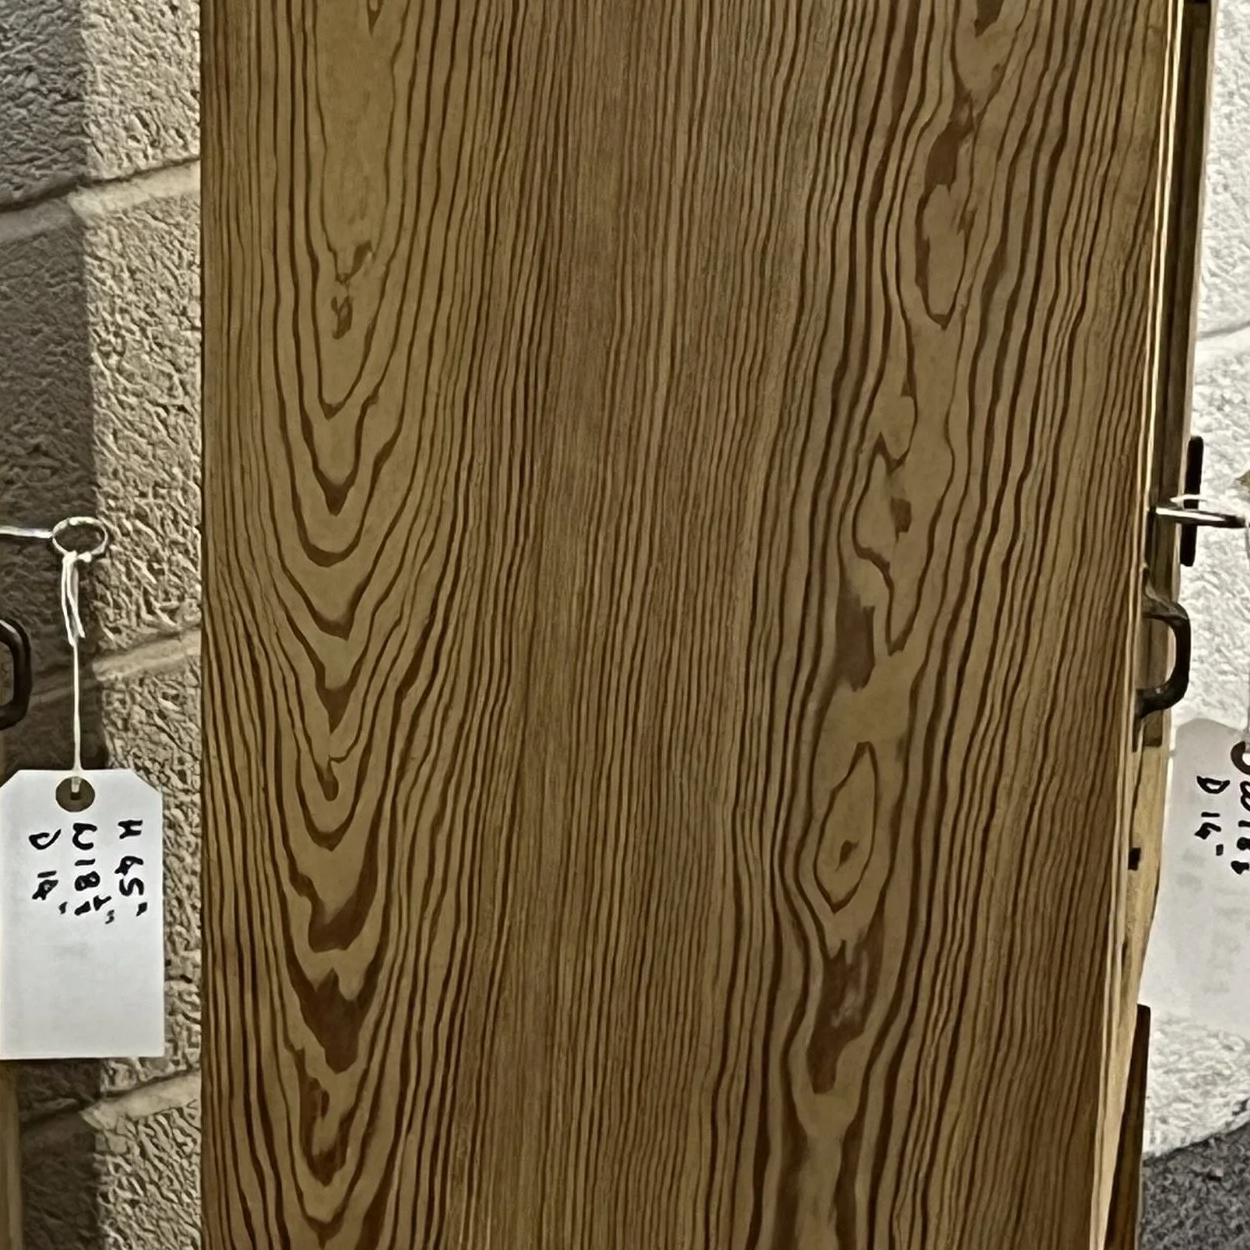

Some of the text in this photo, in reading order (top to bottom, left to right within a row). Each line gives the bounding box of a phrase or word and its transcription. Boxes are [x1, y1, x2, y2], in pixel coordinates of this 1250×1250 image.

[1196, 775, 1231, 795] D
[117, 819, 144, 839] H
[28, 828, 62, 851] D
